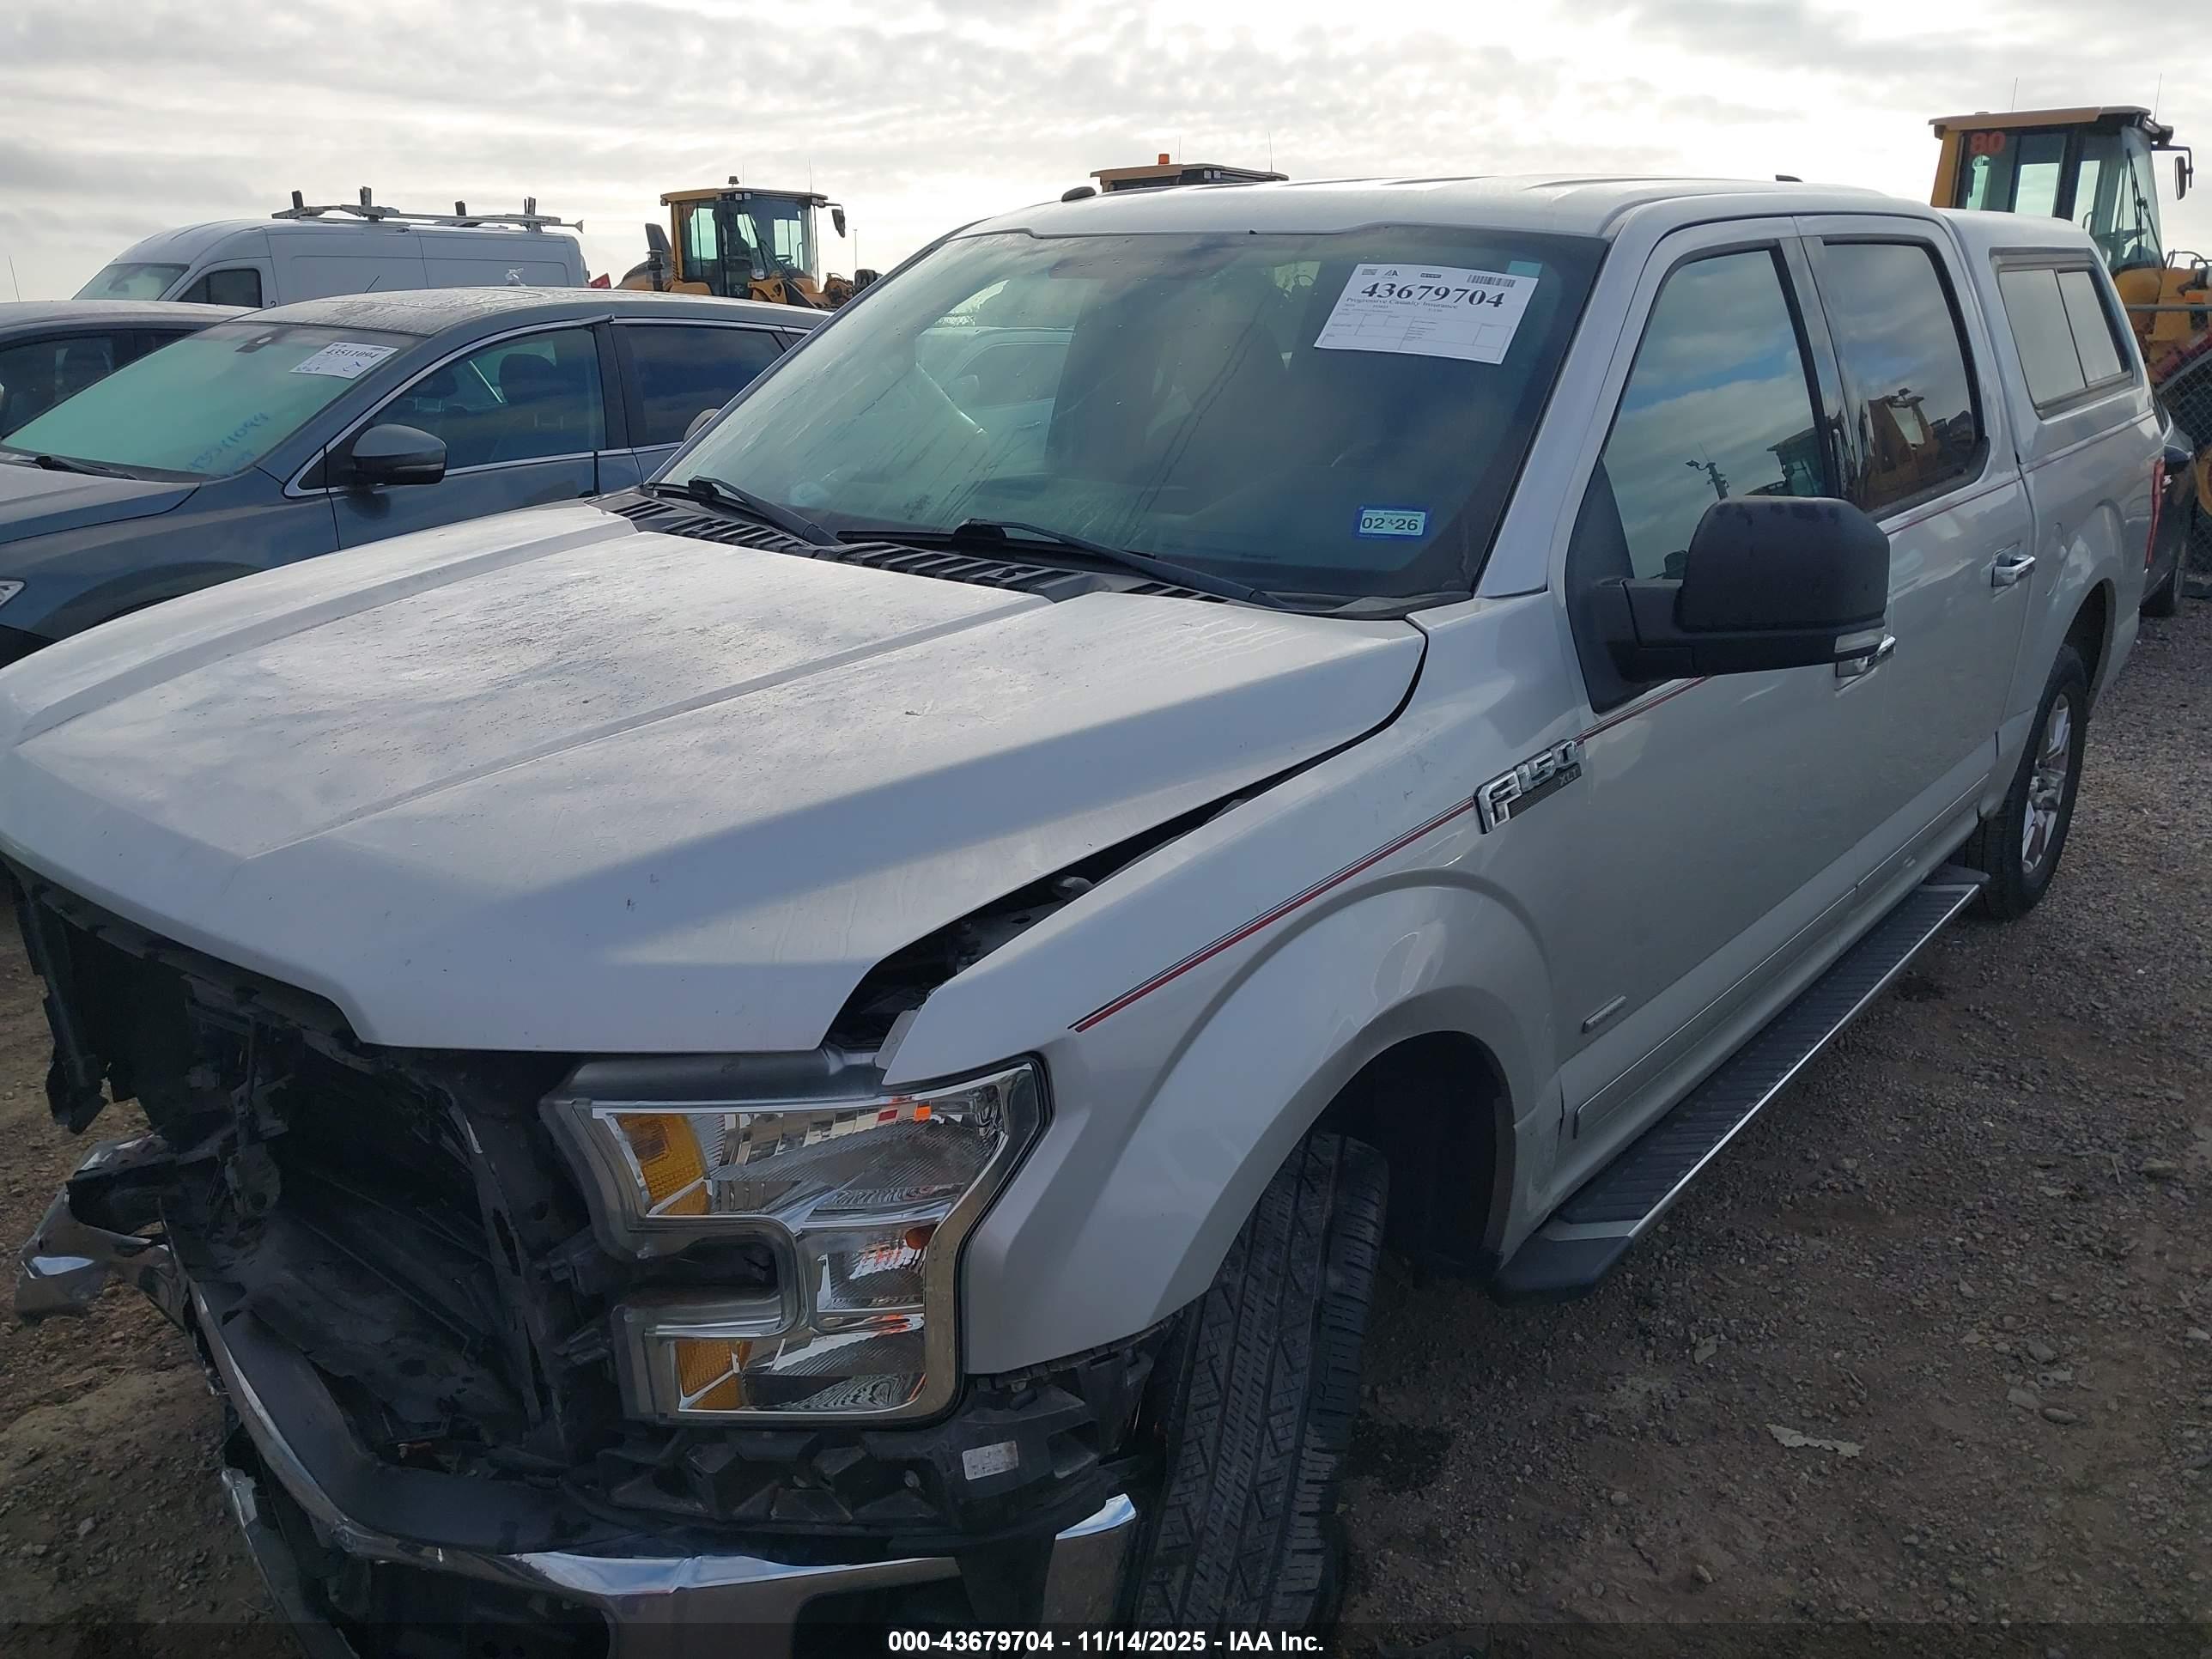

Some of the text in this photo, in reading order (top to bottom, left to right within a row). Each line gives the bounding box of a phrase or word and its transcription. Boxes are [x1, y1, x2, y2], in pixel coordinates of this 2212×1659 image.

[1361, 282, 1505, 308] 43679704
[326, 349, 378, 359] 43511094
[1394, 519, 1419, 531] 26
